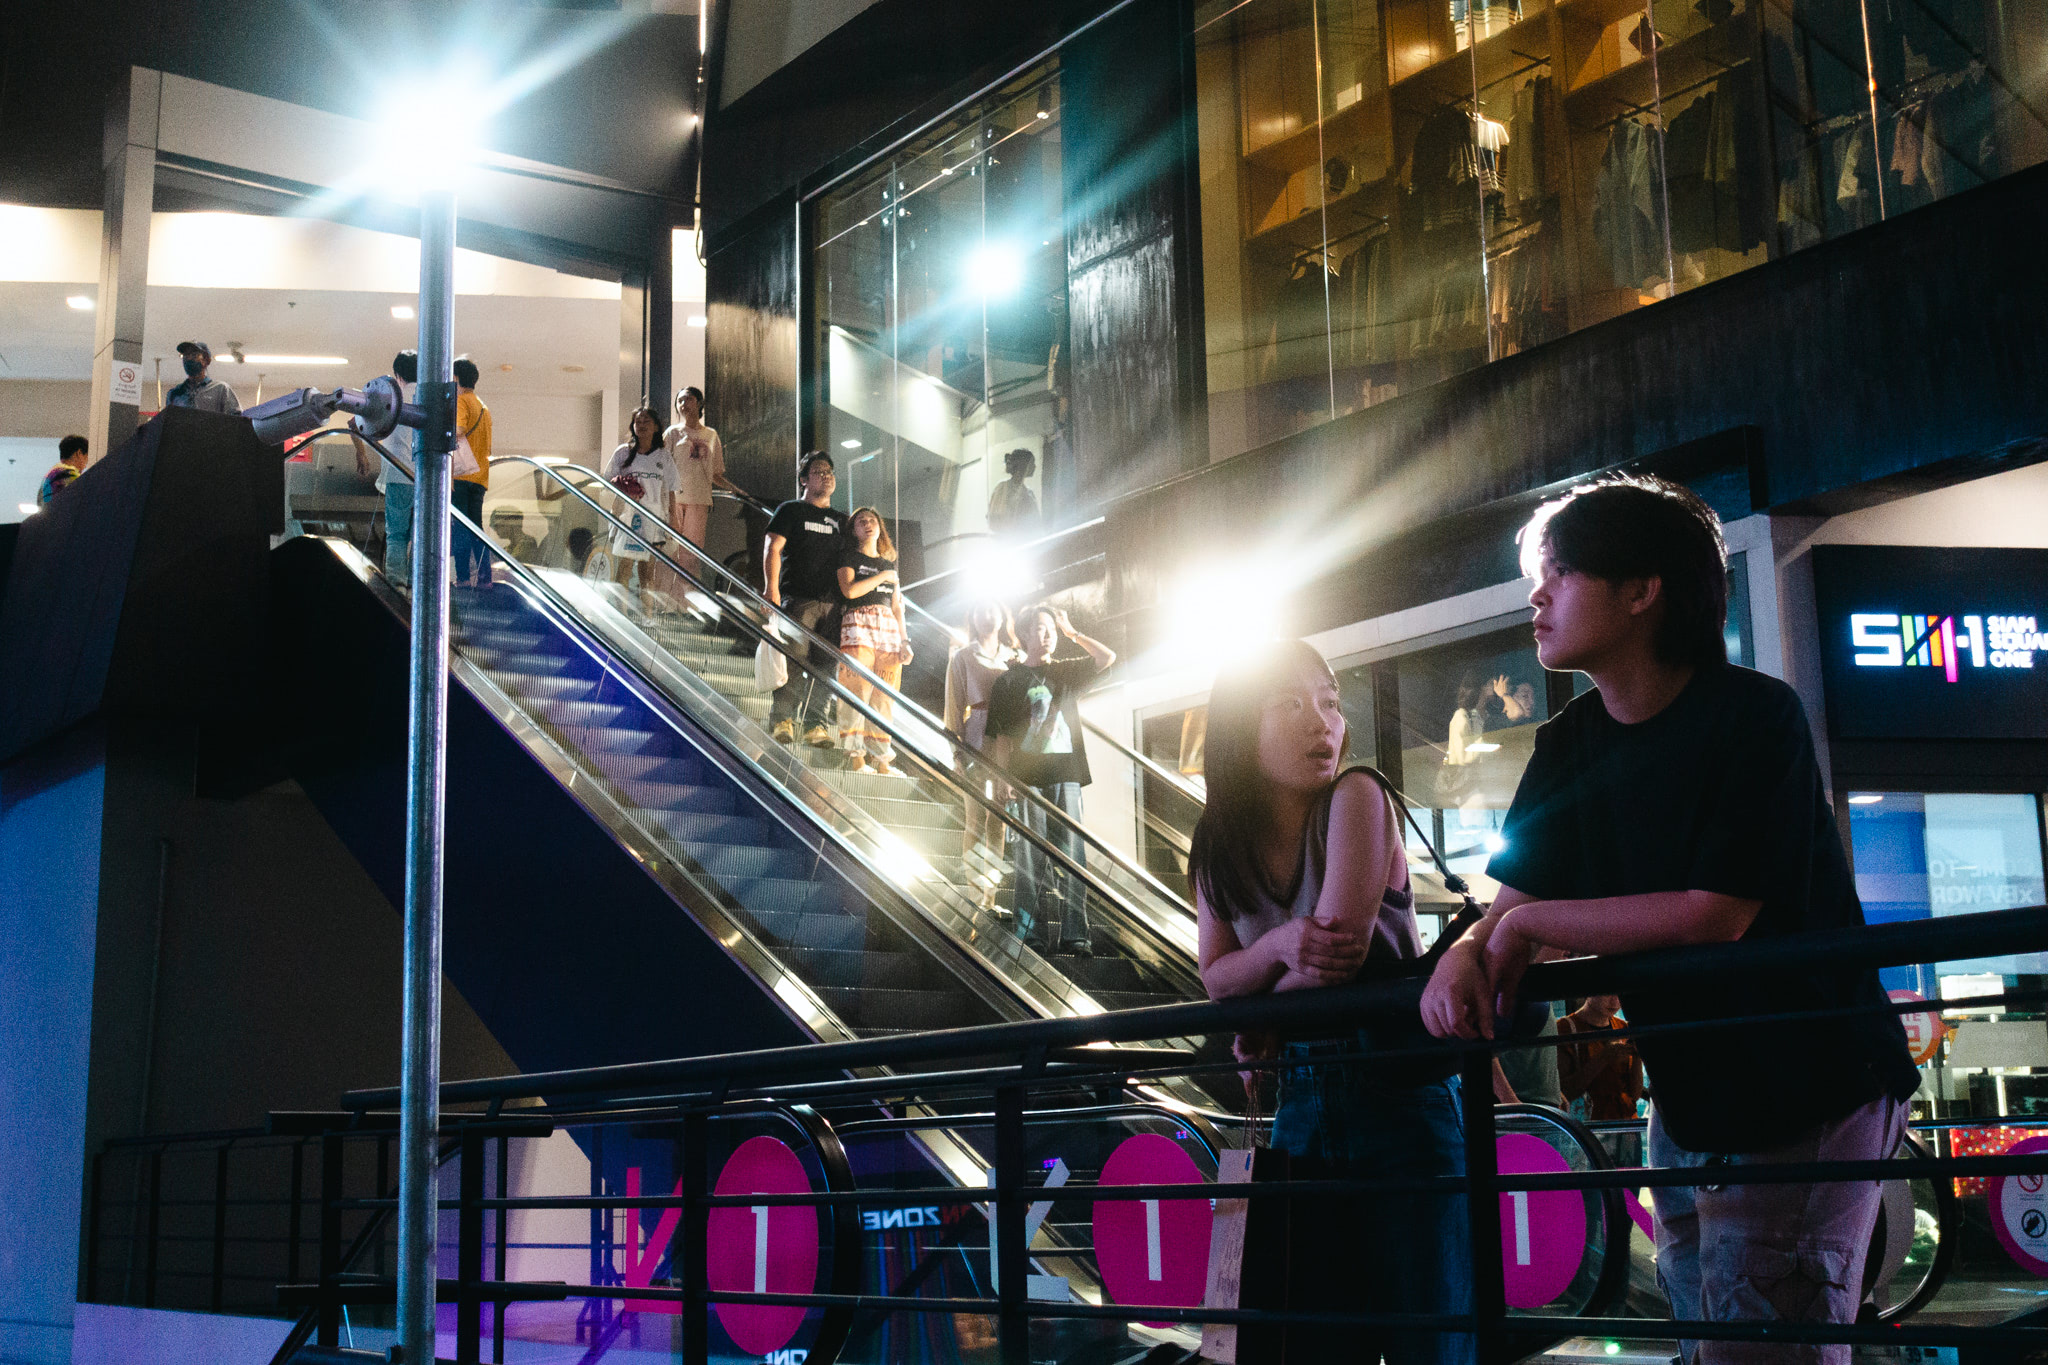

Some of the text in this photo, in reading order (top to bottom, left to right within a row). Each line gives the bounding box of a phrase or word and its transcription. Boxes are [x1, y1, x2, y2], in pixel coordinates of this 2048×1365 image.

[1987, 616, 2036, 633] SIAM
[1990, 650, 2033, 668] ONE
[751, 1191, 769, 1294] 1
[1138, 1183, 1162, 1282] 1
